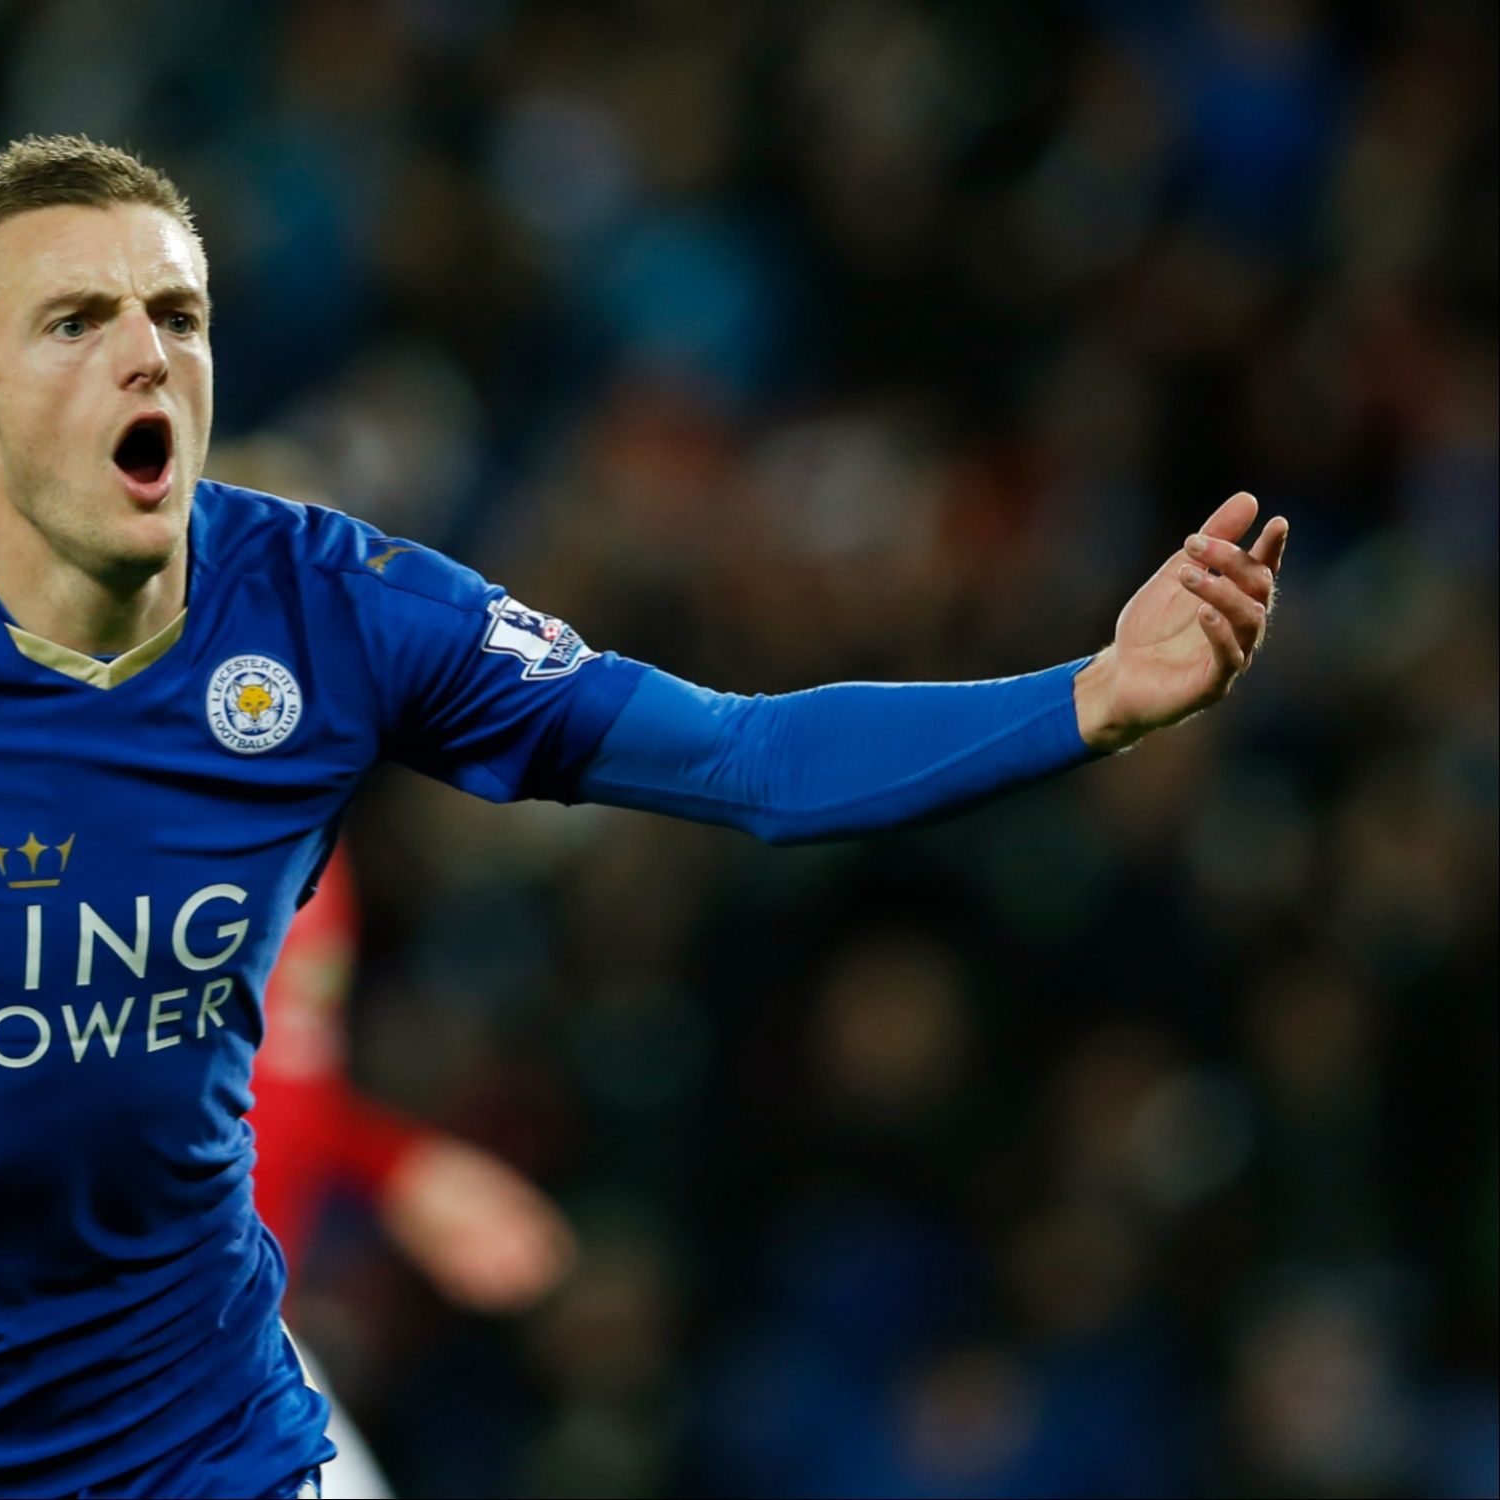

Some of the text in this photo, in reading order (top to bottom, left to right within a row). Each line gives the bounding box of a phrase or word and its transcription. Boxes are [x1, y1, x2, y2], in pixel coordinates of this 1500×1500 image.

[212, 659, 297, 703] LEICESTER CITY
[212, 704, 297, 749] FOOTBALL CLUB
